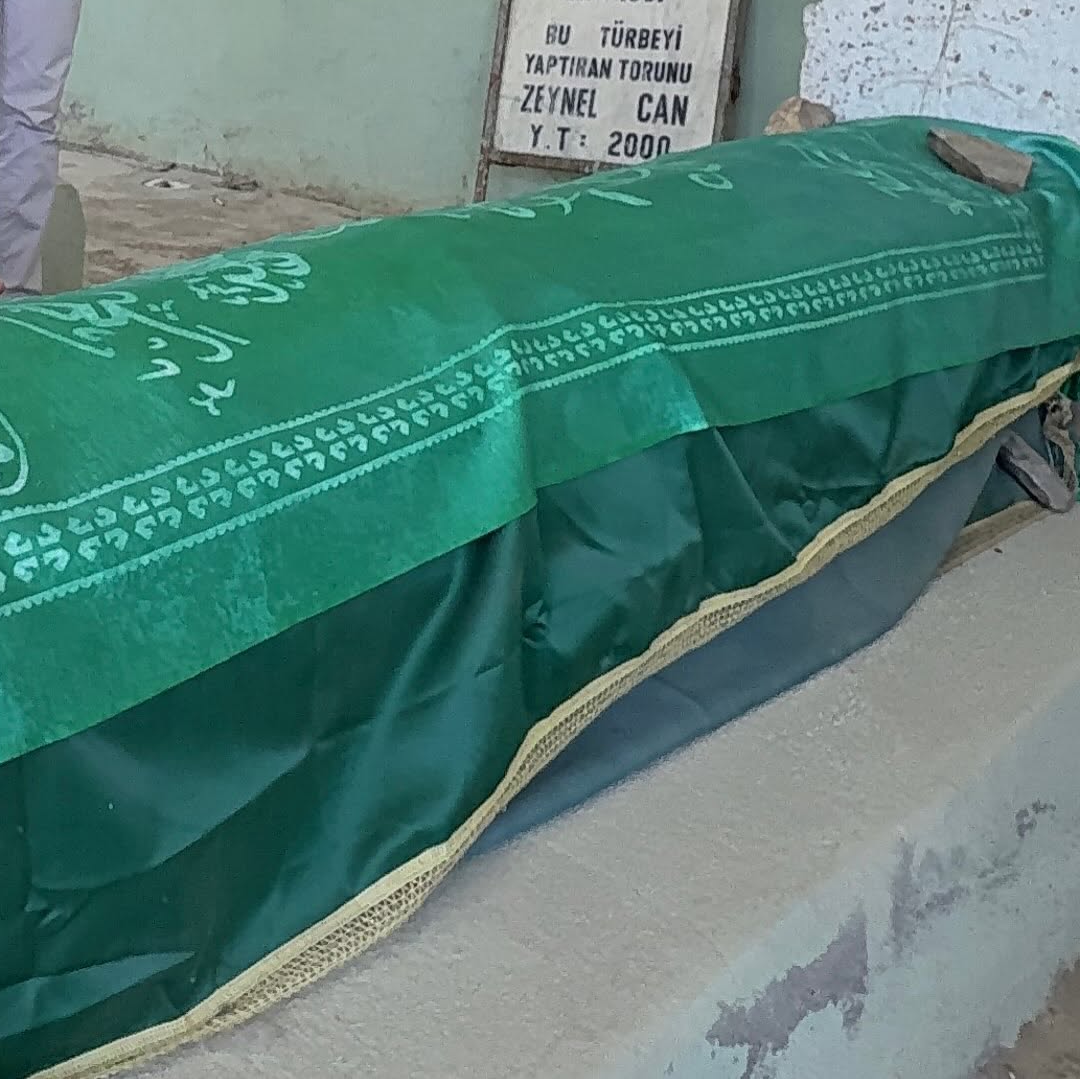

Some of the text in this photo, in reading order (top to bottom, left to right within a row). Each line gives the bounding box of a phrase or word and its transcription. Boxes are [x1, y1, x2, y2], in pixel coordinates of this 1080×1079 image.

[546, 20, 683, 51] BU TÜRBEYİ
[525, 53, 692, 84] YAPTIRAN TORUNU
[520, 84, 689, 126] ZEYNEL CAN
[608, 131, 671, 159] 2000
